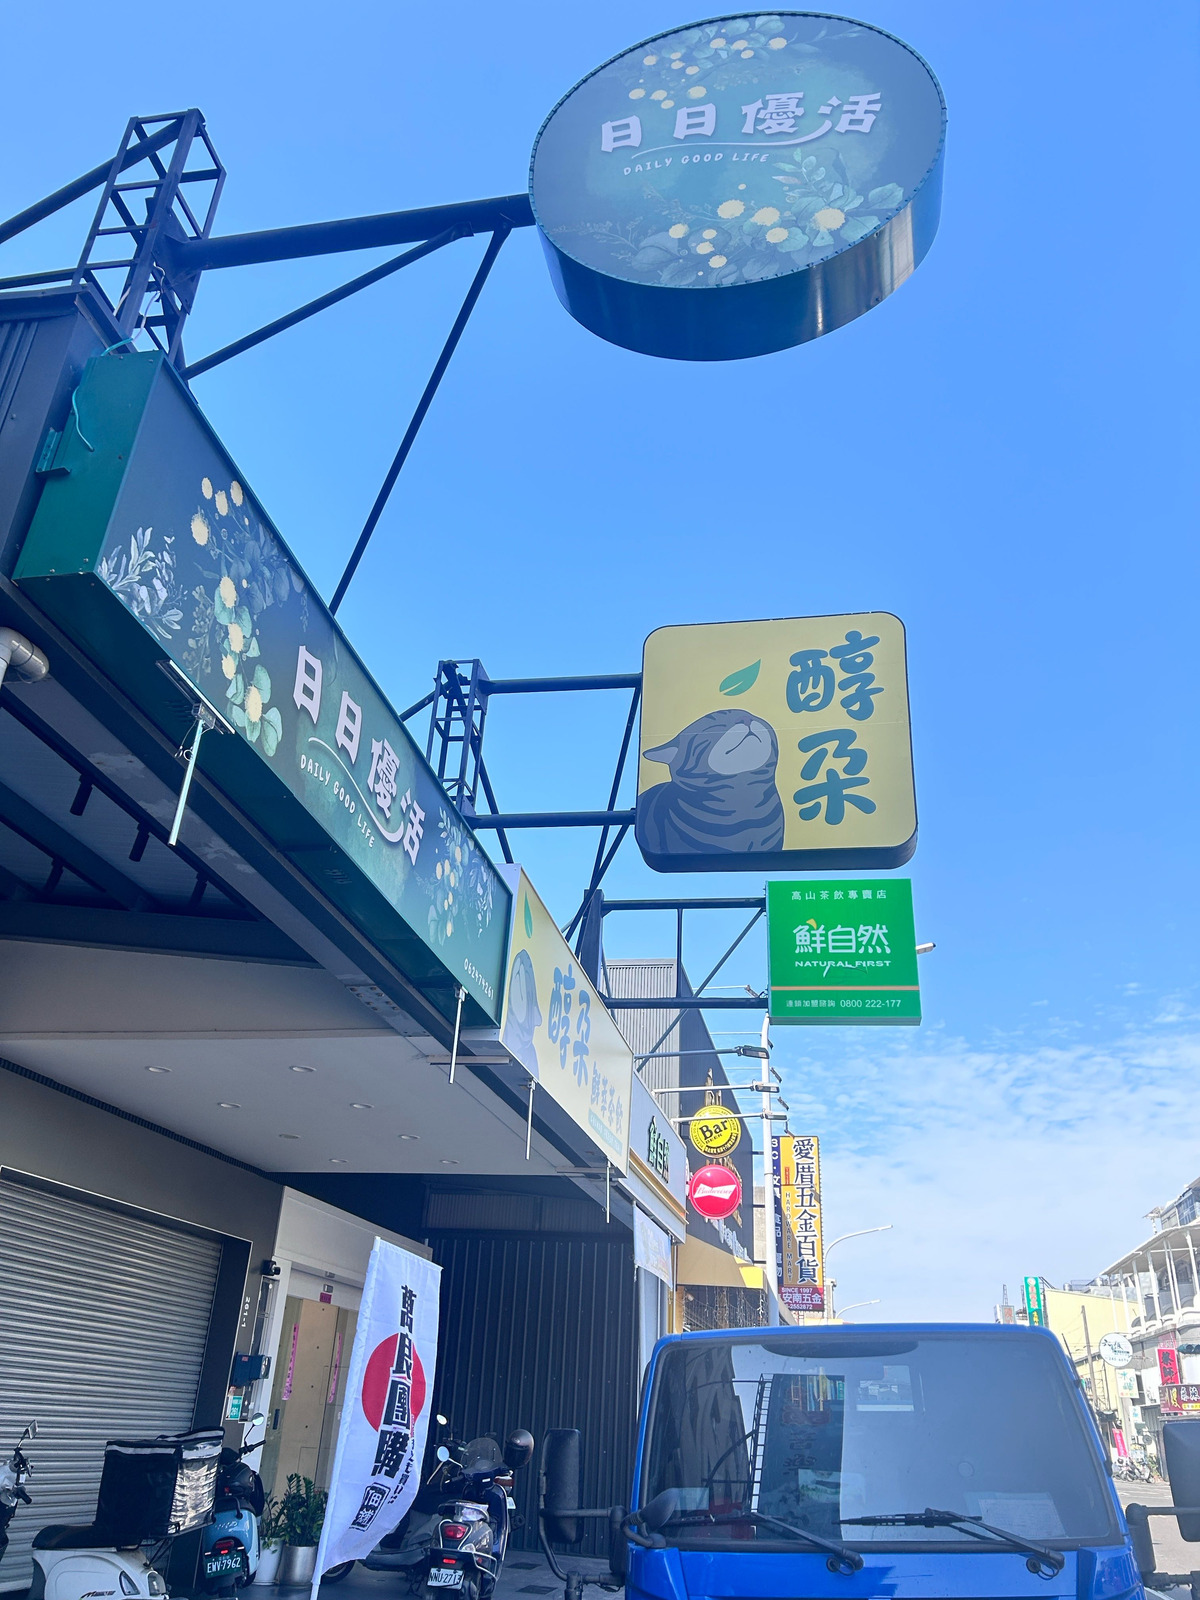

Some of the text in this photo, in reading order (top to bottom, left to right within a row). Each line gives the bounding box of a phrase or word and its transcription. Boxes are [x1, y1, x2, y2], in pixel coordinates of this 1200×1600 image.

[601, 92, 882, 153] 日日優活
[623, 152, 770, 176] DAILY GOOD LIFE
[786, 630, 885, 826] 醇朵
[293, 645, 426, 866] 日日優活
[300, 754, 375, 848] DAILY GOOD LIFE
[791, 889, 887, 901] 高山茶飲專賣店
[792, 923, 892, 954] 鮮自然
[794, 960, 892, 970] NATURAL FIRST
[840, 999, 863, 1008] 0800
[865, 999, 902, 1008] 222-177
[547, 963, 591, 1088] 醇朵
[699, 1119, 728, 1141] Bar
[792, 1137, 819, 1284] 愛厝五金百貨
[241, 1296, 250, 1328] 201-1
[782, 1293, 822, 1304] 安南五金
